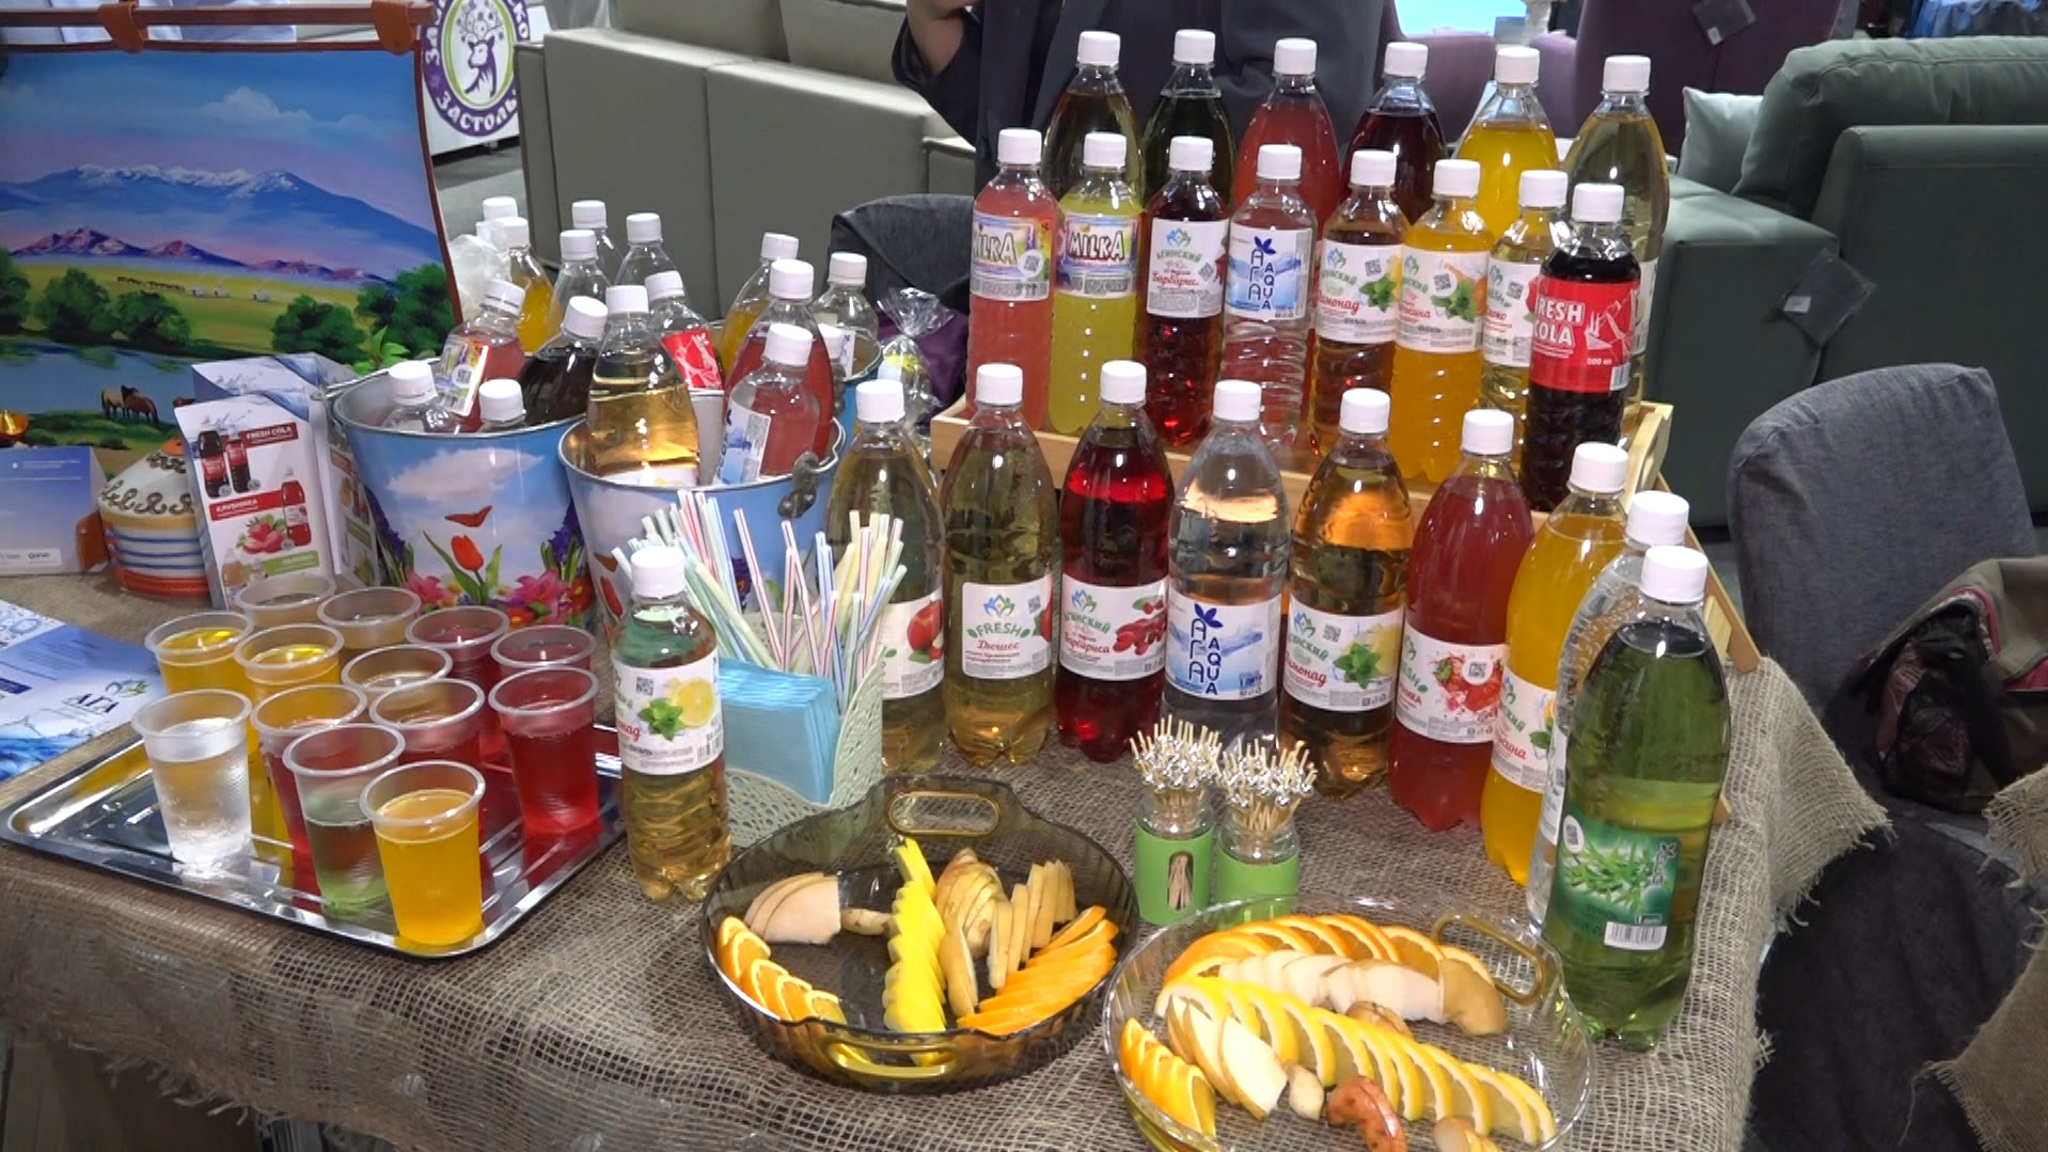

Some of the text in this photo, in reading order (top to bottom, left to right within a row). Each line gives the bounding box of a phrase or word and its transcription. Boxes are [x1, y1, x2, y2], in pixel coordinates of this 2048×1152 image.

[436, 89, 518, 133] ЗАСТОЛЬ
[1262, 262, 1276, 310] AQUA
[1536, 297, 1585, 324] RESH
[976, 622, 1022, 637] FRESH
[1205, 637, 1222, 696] AQUA
